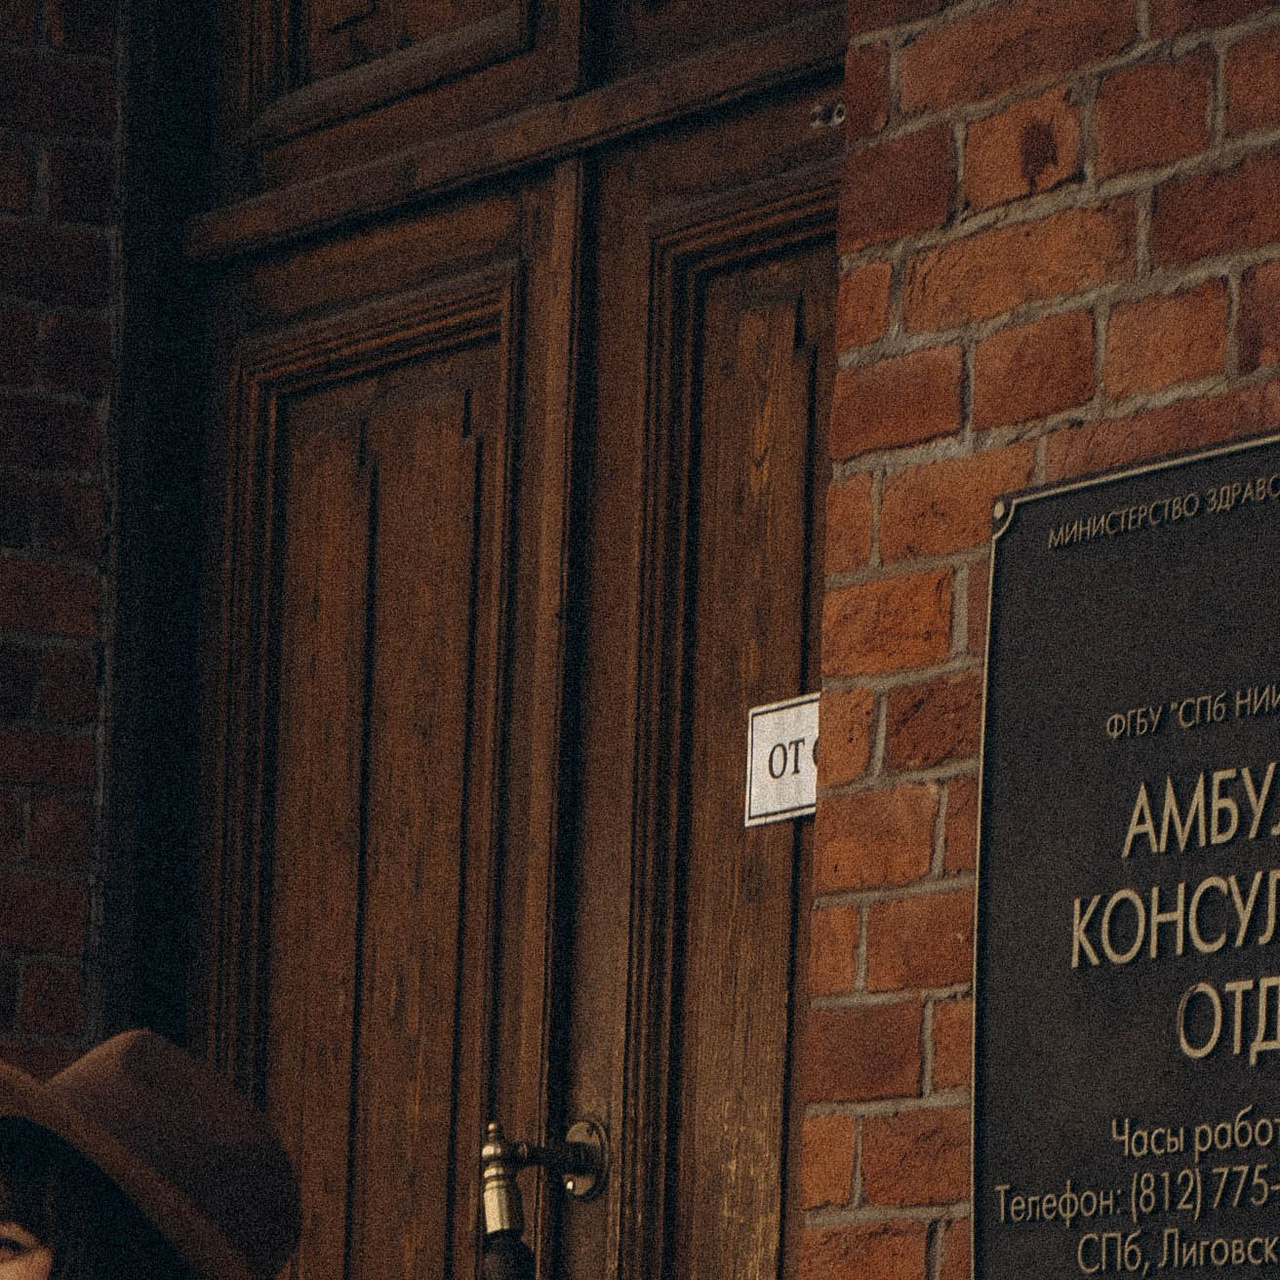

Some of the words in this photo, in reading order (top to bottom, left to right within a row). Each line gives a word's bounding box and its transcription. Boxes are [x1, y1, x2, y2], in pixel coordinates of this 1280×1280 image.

[1048, 493, 1199, 549] МИНИСТЕРСТВО
[1106, 704, 1163, 738] ФГБУ
[768, 738, 805, 779] ОТ
[1121, 762, 1280, 857] АМБУ
[1177, 976, 1280, 1066] ОТД
[1111, 1117, 1185, 1156] Часы
[995, 1180, 1122, 1228] Телефон:
[1130, 1167, 1202, 1222] (812)
[1078, 1229, 1150, 1276] СПб,
[1158, 1228, 1280, 1269] Лиговск
